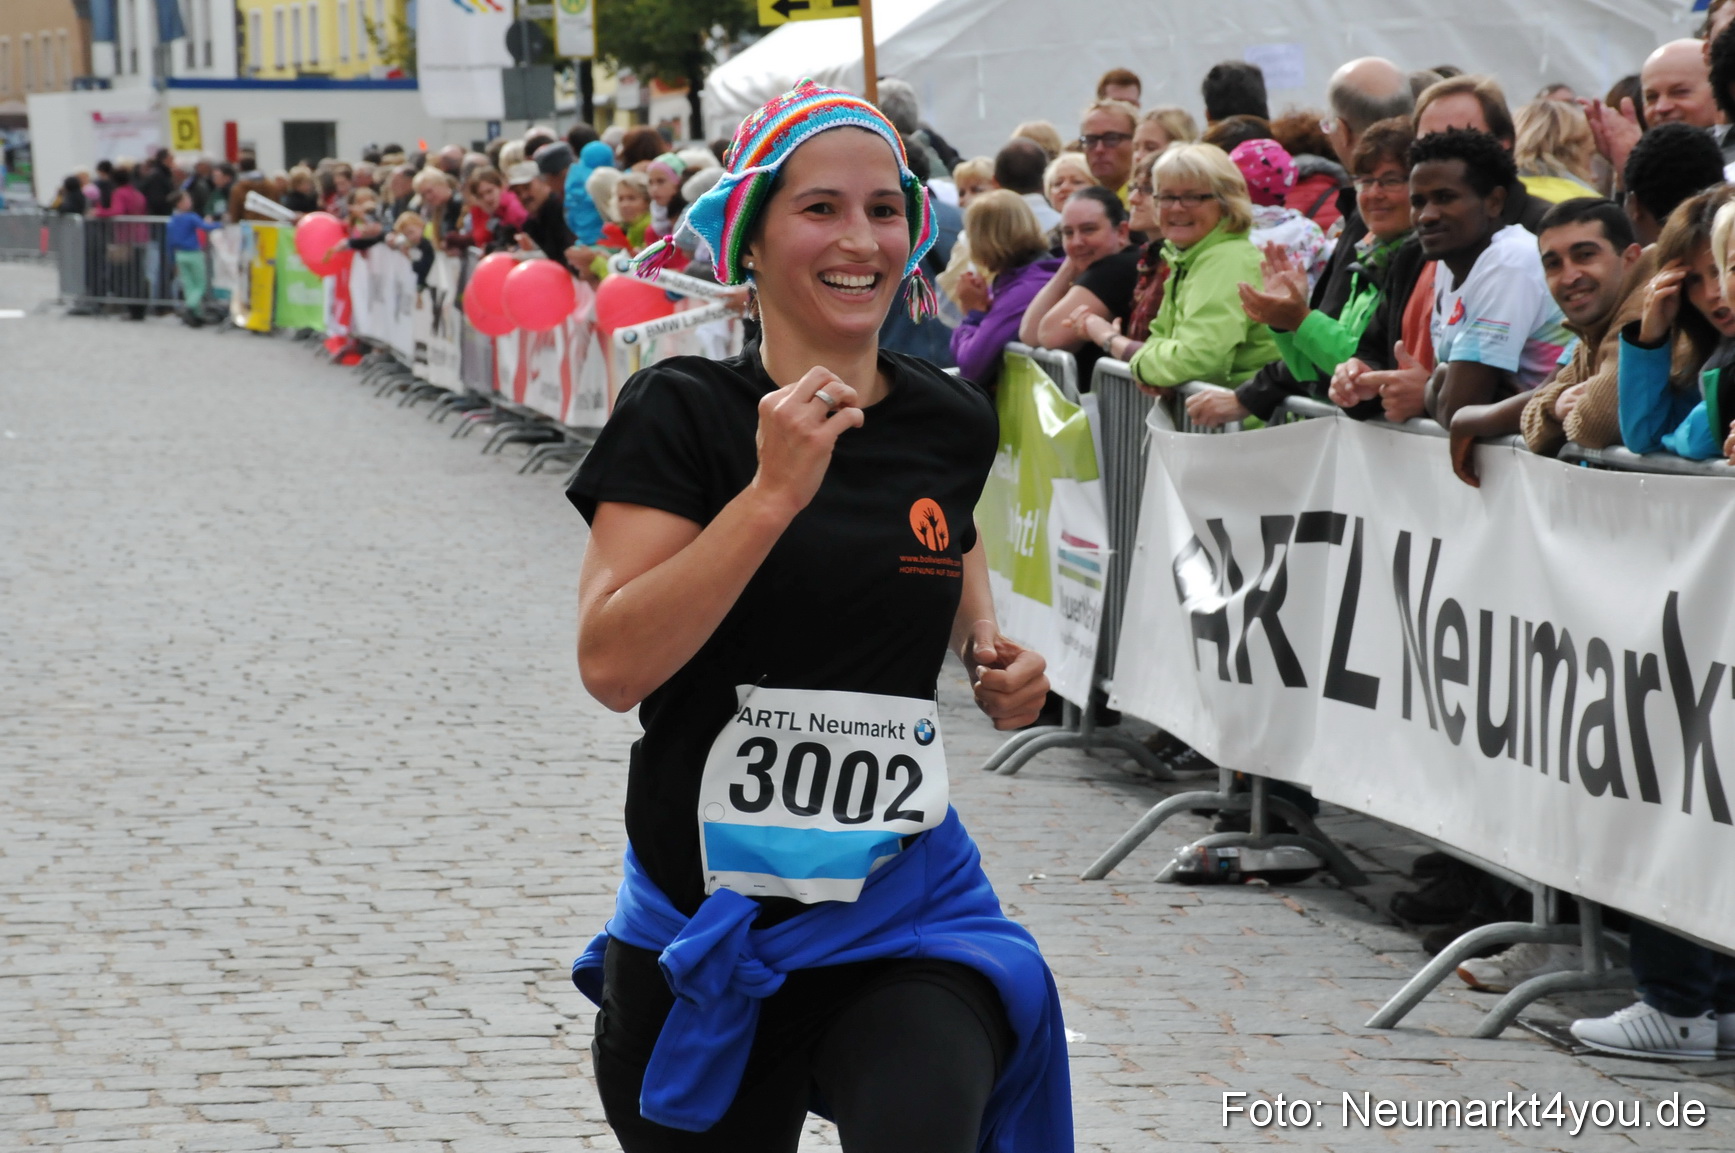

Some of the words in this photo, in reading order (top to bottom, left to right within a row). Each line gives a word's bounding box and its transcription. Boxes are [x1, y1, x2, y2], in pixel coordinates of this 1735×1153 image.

[178, 119, 193, 141] D
[646, 318, 678, 338] BMW
[899, 567, 935, 575] HOFFNUNG
[1172, 510, 1381, 710] ARTL
[1393, 529, 1735, 826] Neumark
[737, 706, 802, 731] ARTL
[808, 712, 906, 740] Neumarkt
[729, 736, 925, 824] 3002
